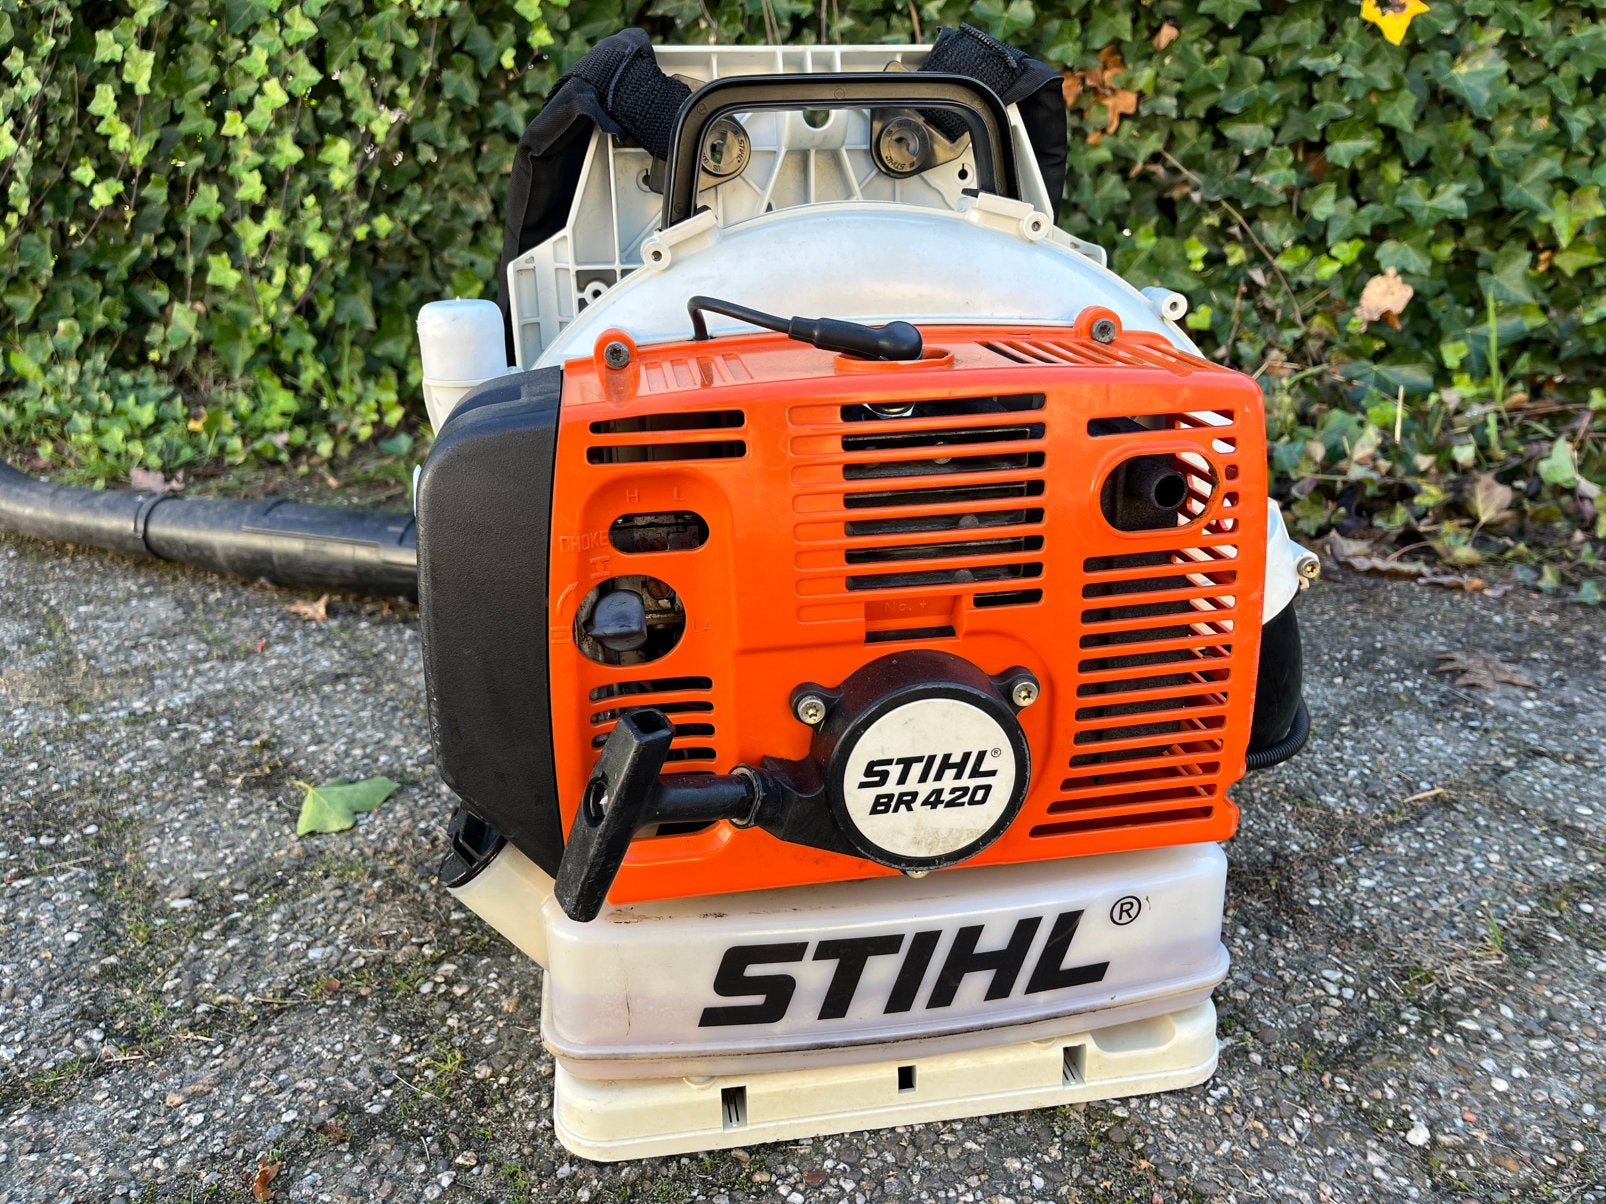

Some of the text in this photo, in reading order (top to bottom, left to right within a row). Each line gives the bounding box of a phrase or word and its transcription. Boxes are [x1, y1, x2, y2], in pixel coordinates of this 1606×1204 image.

[626, 489, 640, 504] H
[559, 530, 609, 552] CHOKE
[857, 750, 998, 789] STIHL
[698, 909, 1110, 1027] STIHL
